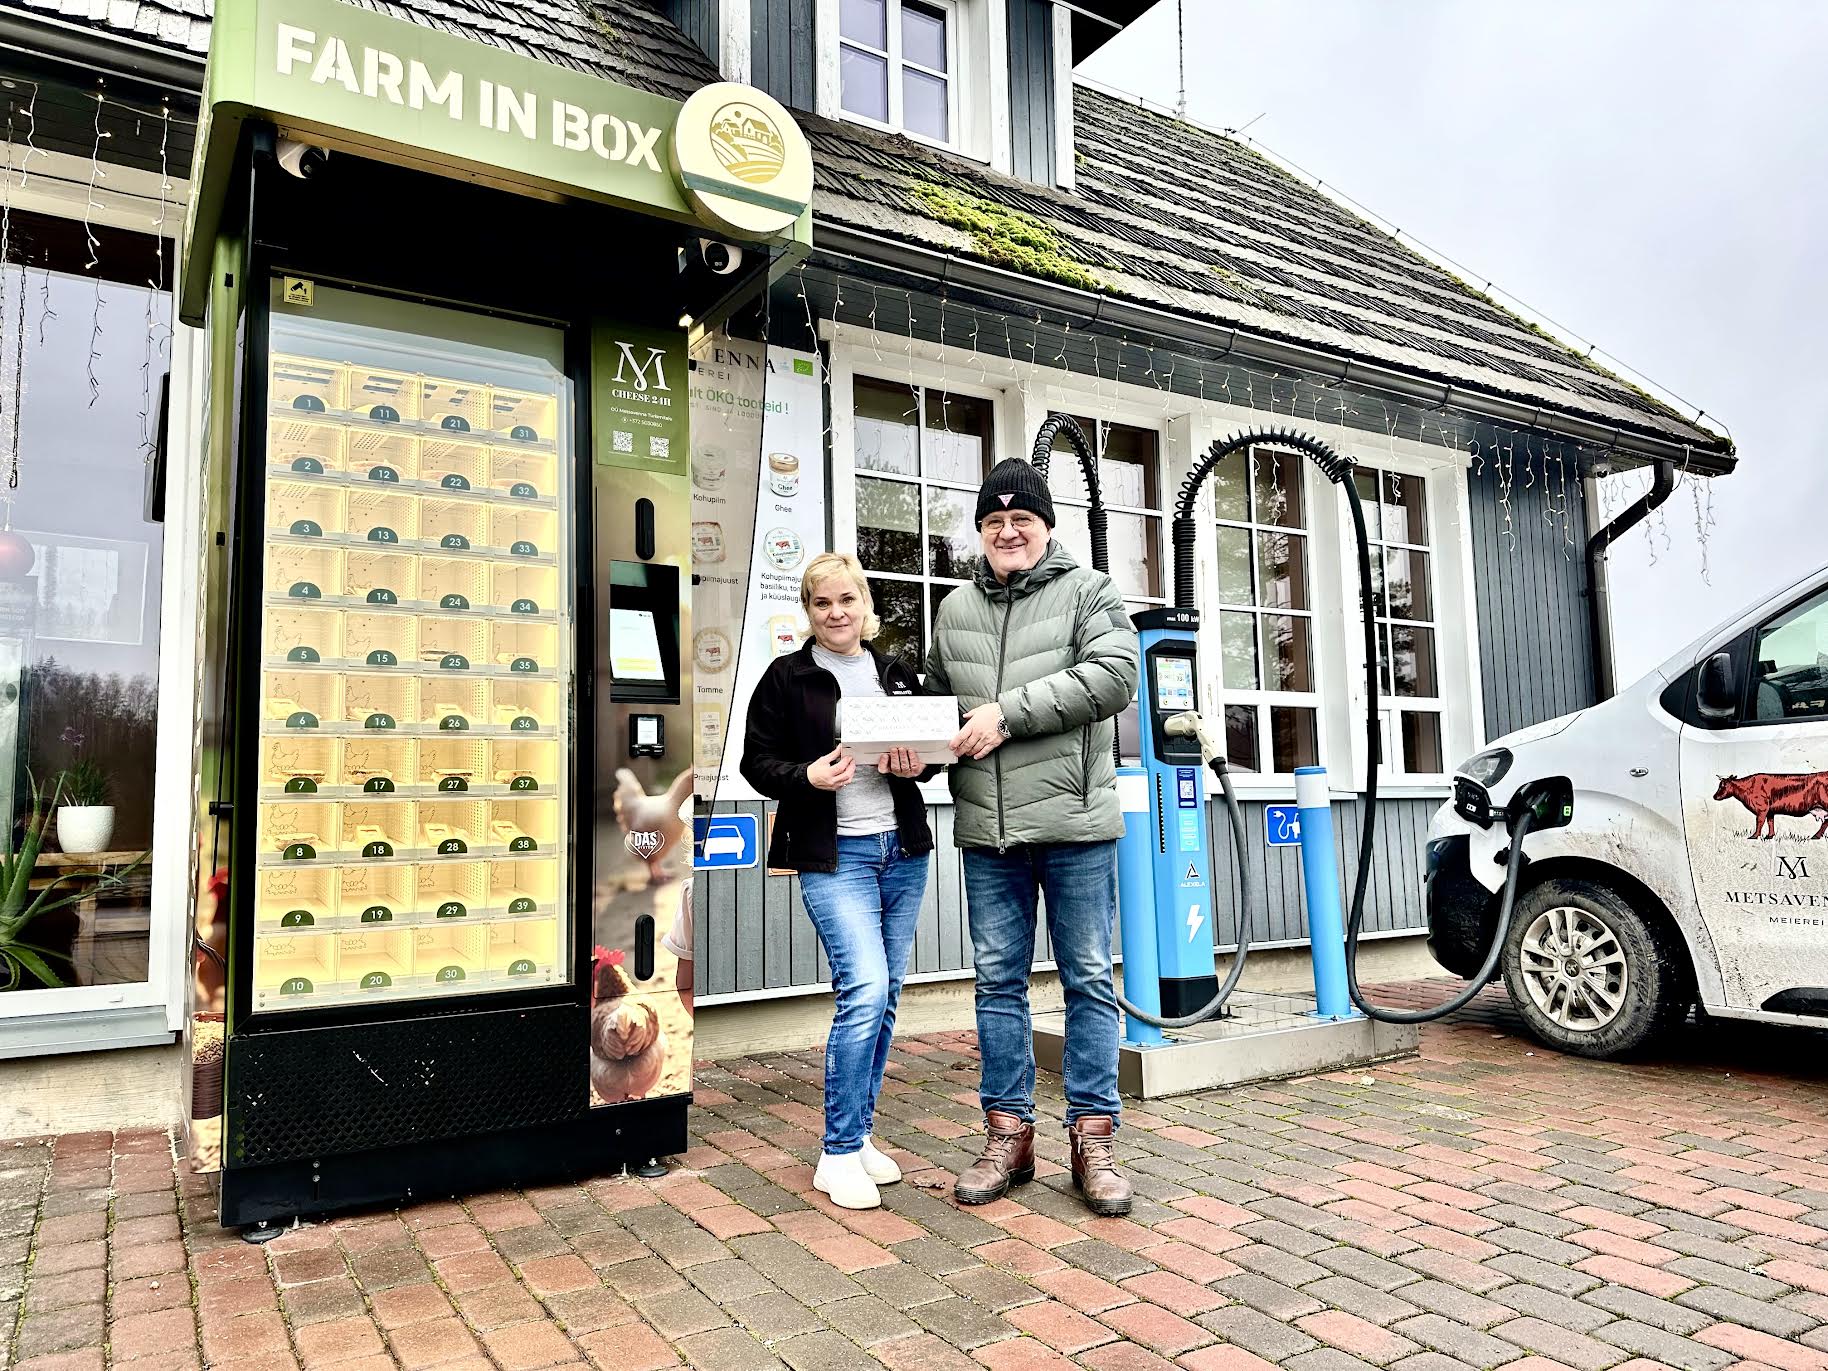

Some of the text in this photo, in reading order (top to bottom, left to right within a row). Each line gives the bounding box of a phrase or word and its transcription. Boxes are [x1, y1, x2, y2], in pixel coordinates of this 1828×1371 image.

[276, 22, 664, 173] FARM IN BOX
[691, 346, 776, 374] VENNA
[698, 367, 731, 381] EREI
[611, 388, 651, 403] CHEESE
[652, 395, 672, 407] 24H
[706, 386, 735, 405] ÖKO
[737, 394, 782, 414] tooteid
[380, 409, 390, 418] 11
[450, 419, 461, 428] 21
[519, 430, 529, 438] 31
[378, 469, 390, 479] 12
[449, 477, 462, 487] 22
[518, 486, 530, 495] 32
[777, 483, 793, 492] Ghee
[693, 493, 727, 505] Kohupiim
[774, 504, 793, 513] Ghee
[378, 530, 390, 540] 13
[449, 537, 462, 547] 23
[519, 544, 531, 553] 33
[699, 574, 739, 586] piimajuust
[761, 572, 802, 584] Kohupiimaju
[376, 592, 389, 601] 14
[448, 597, 461, 606] 24
[519, 602, 531, 611] 34
[1176, 612, 1190, 623] 100
[1190, 615, 1200, 623] kW
[376, 653, 388, 663] 15
[448, 657, 461, 667] 25
[519, 661, 531, 670] 35
[697, 685, 724, 695] Tomme
[374, 717, 387, 726] 16
[448, 718, 461, 728] 26
[519, 719, 531, 729] 36
[373, 781, 386, 790] 17
[447, 780, 460, 789] 27
[518, 779, 531, 789] 37
[517, 839, 530, 849] 38
[634, 831, 657, 847] DAS
[372, 845, 385, 855] 18
[446, 842, 459, 852] 28
[445, 905, 458, 915] 29
[516, 901, 529, 911] 39
[371, 909, 384, 920] 19
[1769, 916, 1824, 926] MEIEREI
[516, 962, 529, 972] 40
[444, 969, 458, 979] 30
[369, 975, 383, 985] 20
[291, 981, 304, 991] 10
